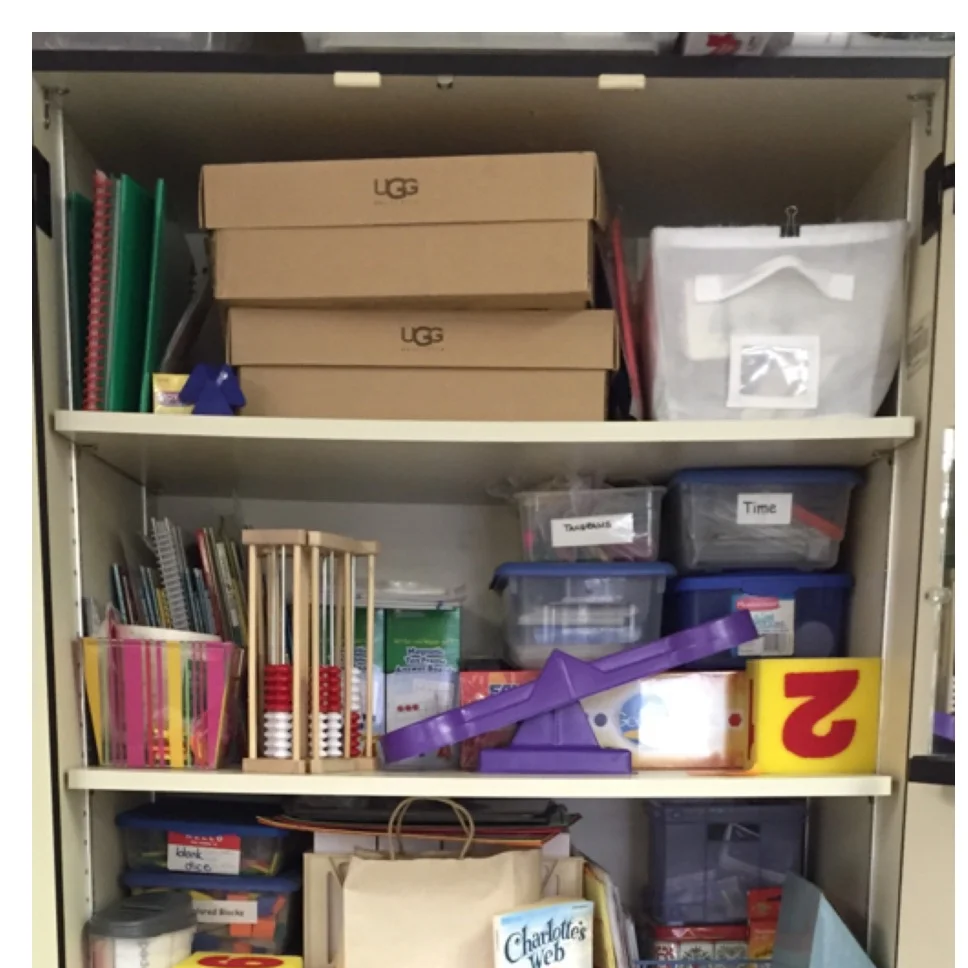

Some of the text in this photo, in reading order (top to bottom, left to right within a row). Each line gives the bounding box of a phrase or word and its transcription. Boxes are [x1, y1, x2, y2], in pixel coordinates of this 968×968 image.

[373, 177, 418, 200] UGG
[401, 325, 444, 347] UGG
[742, 501, 777, 514] Time
[782, 669, 860, 759] 2
[504, 918, 587, 963] Charlotte's
